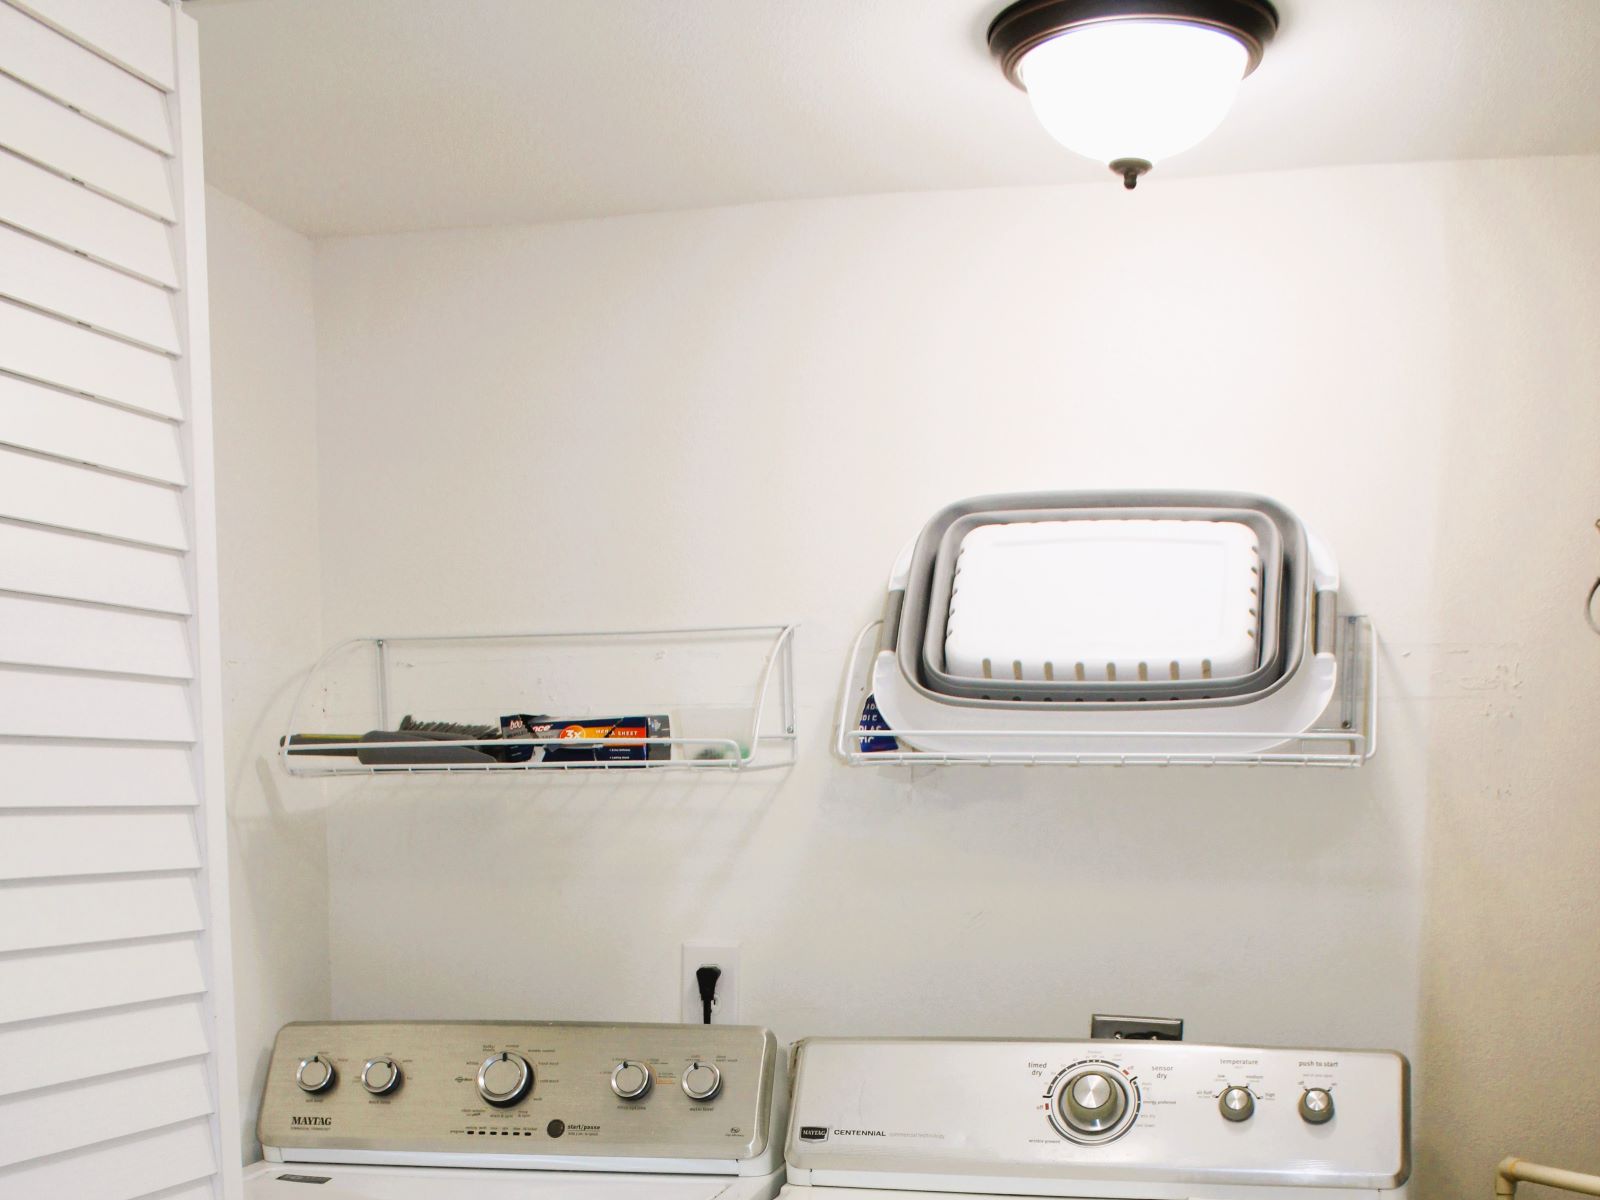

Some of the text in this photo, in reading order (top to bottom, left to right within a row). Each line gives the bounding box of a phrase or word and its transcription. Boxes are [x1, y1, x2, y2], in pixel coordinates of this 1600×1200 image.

[1028, 1061, 1047, 1069] timed
[1031, 1069, 1043, 1077] dry
[291, 1116, 332, 1126] MAYTAG
[833, 1129, 886, 1137] CENTENNIAL
